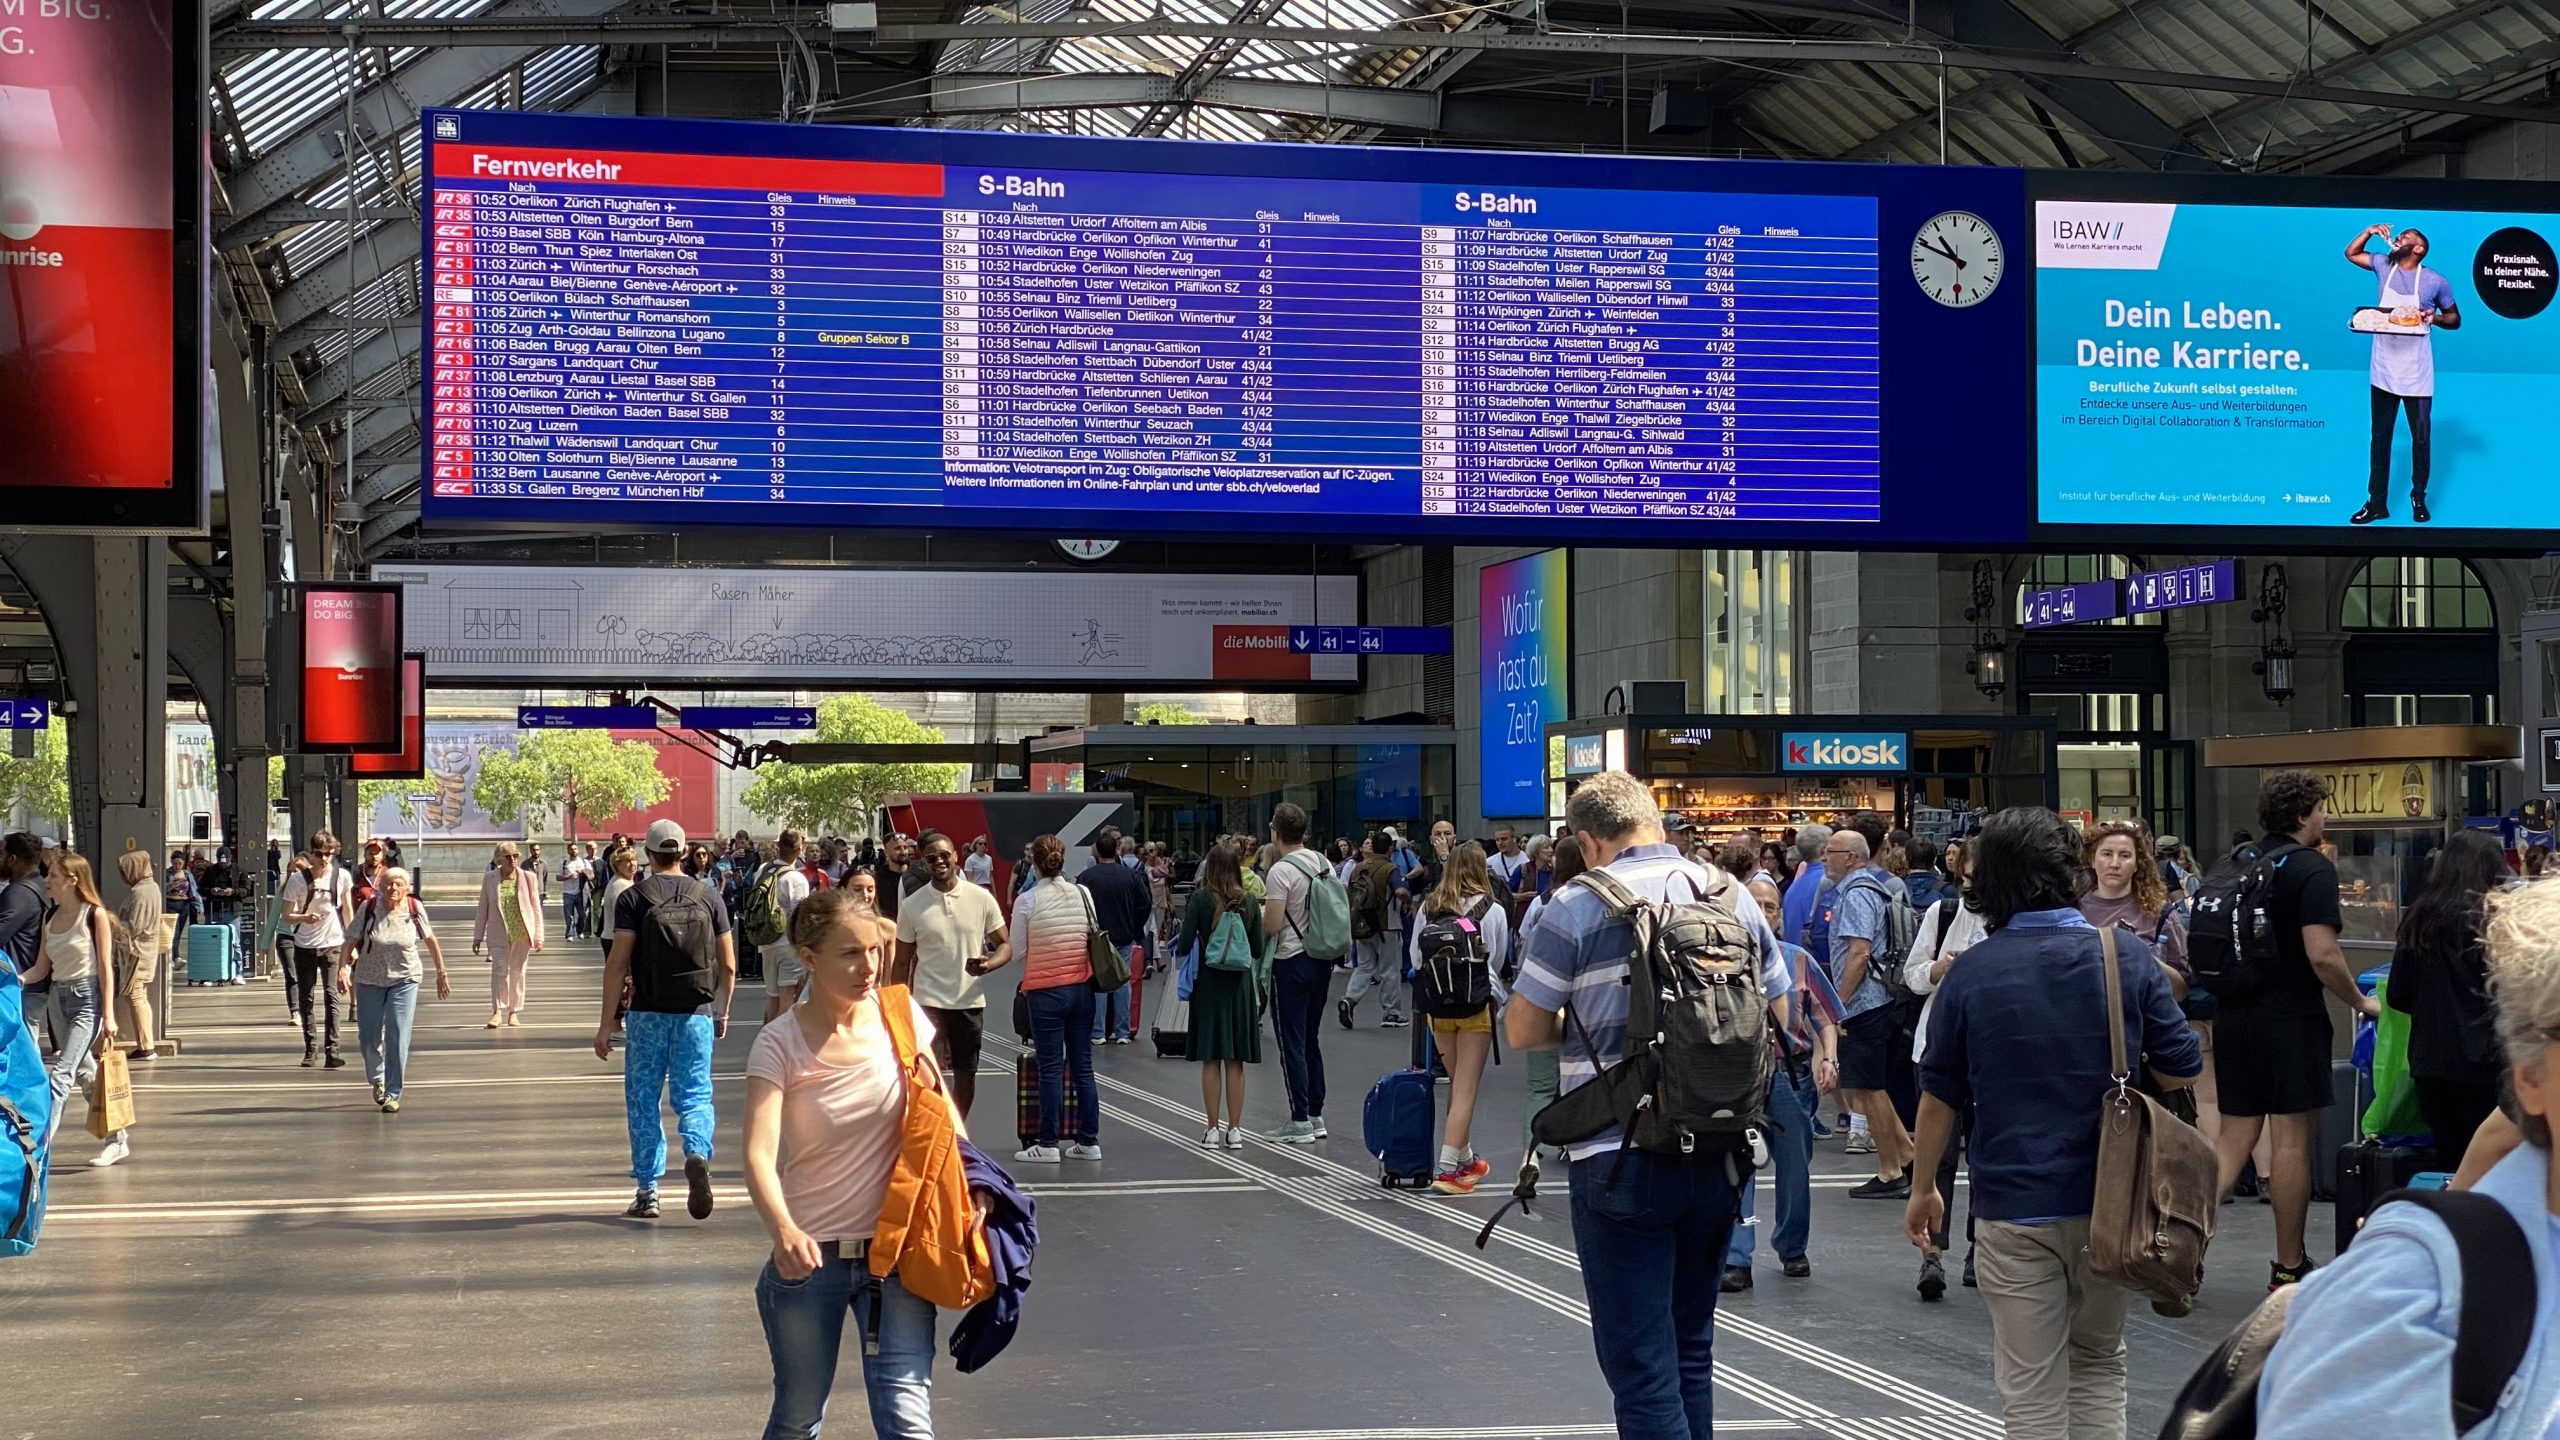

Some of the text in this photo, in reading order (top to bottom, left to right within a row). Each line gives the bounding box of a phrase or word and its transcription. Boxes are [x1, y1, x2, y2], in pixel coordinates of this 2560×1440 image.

[472, 154, 622, 181] Fernverkehr
[509, 182, 536, 193] Nach
[979, 175, 1065, 198] S-Bahn
[436, 192, 785, 216] IR 36 10:52 Oerlikon Zürich Flughafen 33
[766, 192, 792, 203] Gleis
[818, 194, 856, 206] Hinweis
[1455, 192, 1537, 214] S-Bahn
[1012, 202, 1038, 212] Nach
[1256, 211, 1279, 221] Gleis
[1304, 212, 1340, 223] Hinweis
[1488, 218, 1512, 228] Nach
[1718, 225, 1741, 235] Gleis
[1764, 226, 1799, 237] Hinweis
[1423, 229, 1734, 250] S9 11:07 Hardbrücke Oerlikon Schaffhausen 41/42
[2054, 241, 2143, 251] Wo Lernen Karriere macht
[0, 246, 63, 267] nrise
[2493, 253, 2540, 265] Praxisnah.
[2484, 266, 2550, 278] In deiner Nähe.
[945, 274, 1272, 294] S5 10:54 Stadelhofen Uster Wetzikon Pfäffikon SZ 43
[2498, 278, 2535, 290] Flexibel.
[2105, 299, 2282, 331] Dein Leben.
[435, 321, 909, 344] IC 2 11:05 Zug Arth-Goldau Bellinzona Lugano 8 Gruppen Sektor B
[2077, 339, 2310, 371] Deine Karriere.
[2089, 380, 2298, 397] Berufliche Zukunft selbst gestalten:
[2079, 398, 2307, 415] Entdecke unsere Aus- und Weiterbildungen
[2061, 414, 2326, 429] im Bereich Digital Collaboration & Transformation
[945, 463, 1394, 483] Information: Velotransport im Zug: Obligatorische Veloplatzreservation auf IC-Zügen.
[945, 476, 1320, 495] Weitere Informationen im Online-Fahrplan und unter sbb.ch/veloverlad
[2059, 491, 2266, 505] Institut für berufliche Aus- und Weiterbildung
[2295, 493, 2331, 504] ibaw.ch
[1424, 501, 1736, 518] S5 11:24 Stadelhofen Uster Wetzikon Pfäffikon SZ 43/44
[712, 583, 794, 600] Rasen Mäher
[314, 599, 353, 609] DREAM
[2040, 605, 2050, 620] 41
[2062, 600, 2074, 617] 44
[313, 610, 331, 620] DO
[1502, 589, 1543, 637] Wofür
[1223, 635, 1244, 648] die
[1323, 637, 1337, 649] 41
[1362, 637, 1379, 649] 44
[1498, 644, 1547, 692] hast du
[1507, 700, 1539, 745] Zeit?
[1574, 744, 1600, 767] kiosk
[1788, 739, 1899, 765] k kiosk
[2324, 773, 2385, 818] RILL
